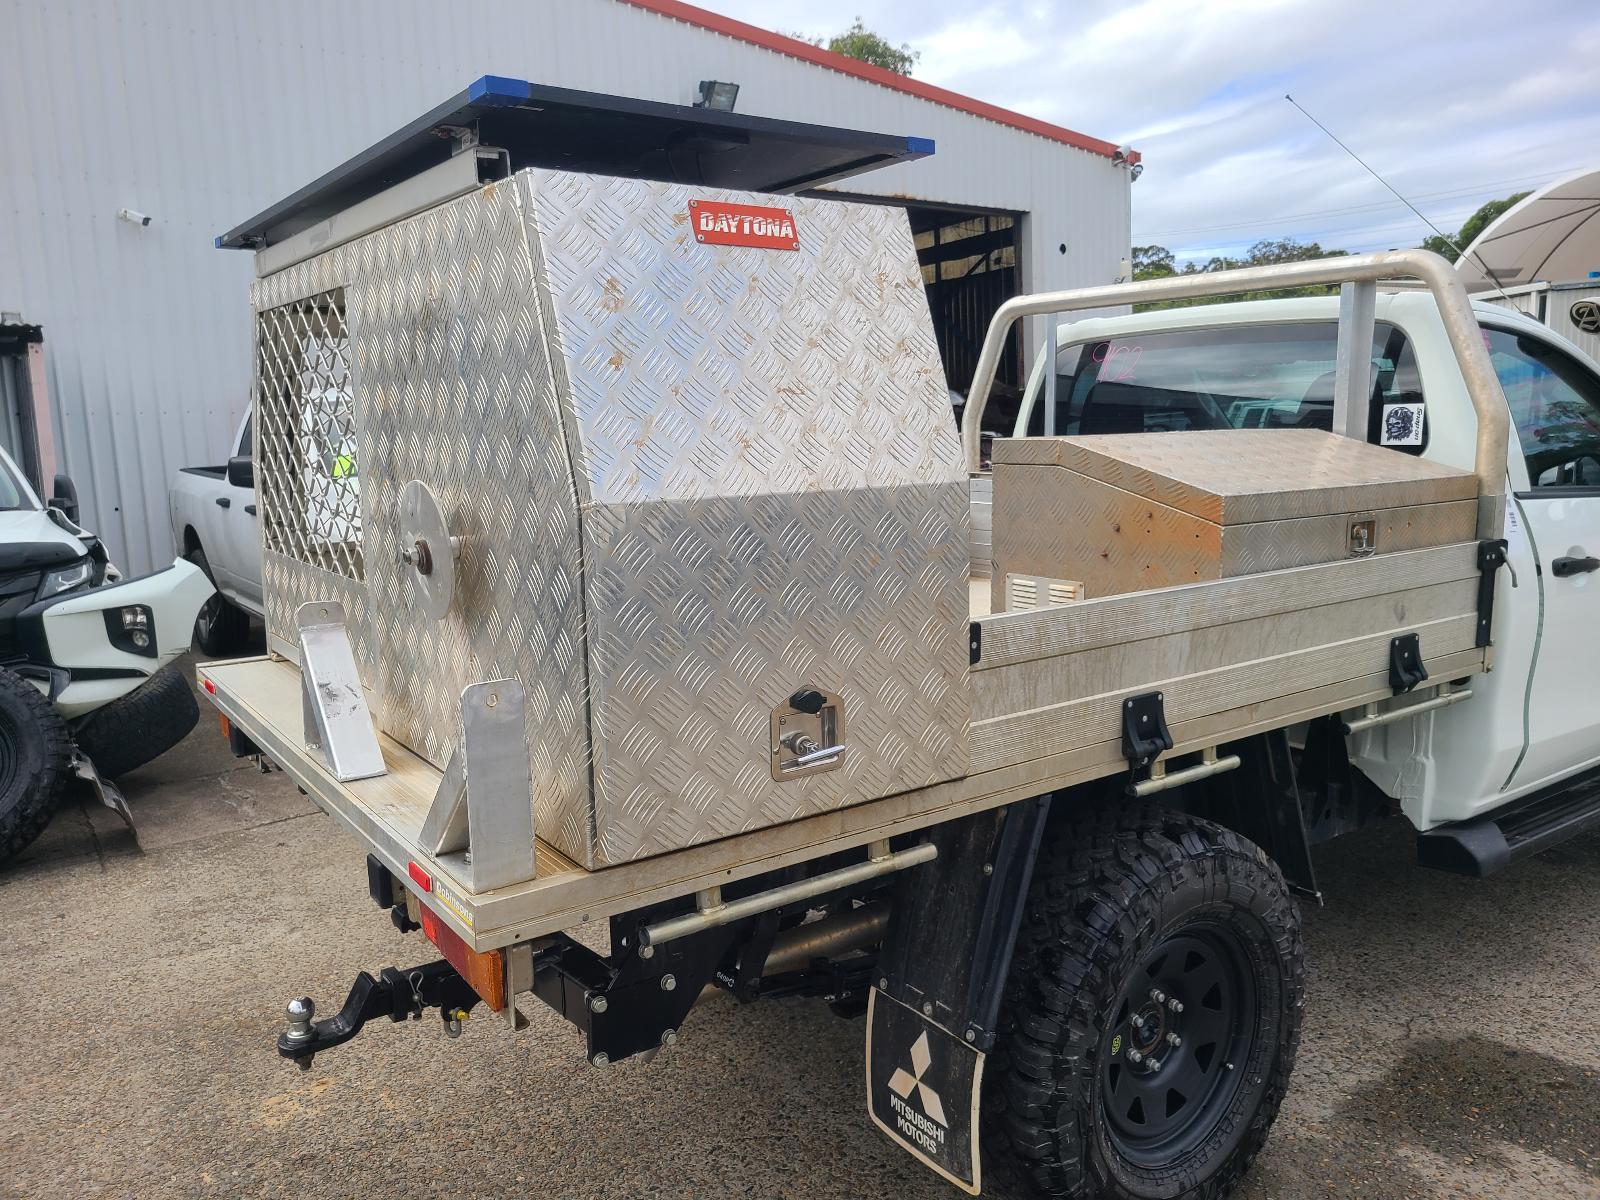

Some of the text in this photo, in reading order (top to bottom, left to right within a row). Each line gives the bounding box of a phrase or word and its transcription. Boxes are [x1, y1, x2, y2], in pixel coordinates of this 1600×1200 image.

[699, 211, 794, 239] DAYTONA
[1414, 407, 1423, 441] Snap-on
[890, 1094, 945, 1144] MITSUBISHI
[897, 1115, 937, 1154] MOTORS
